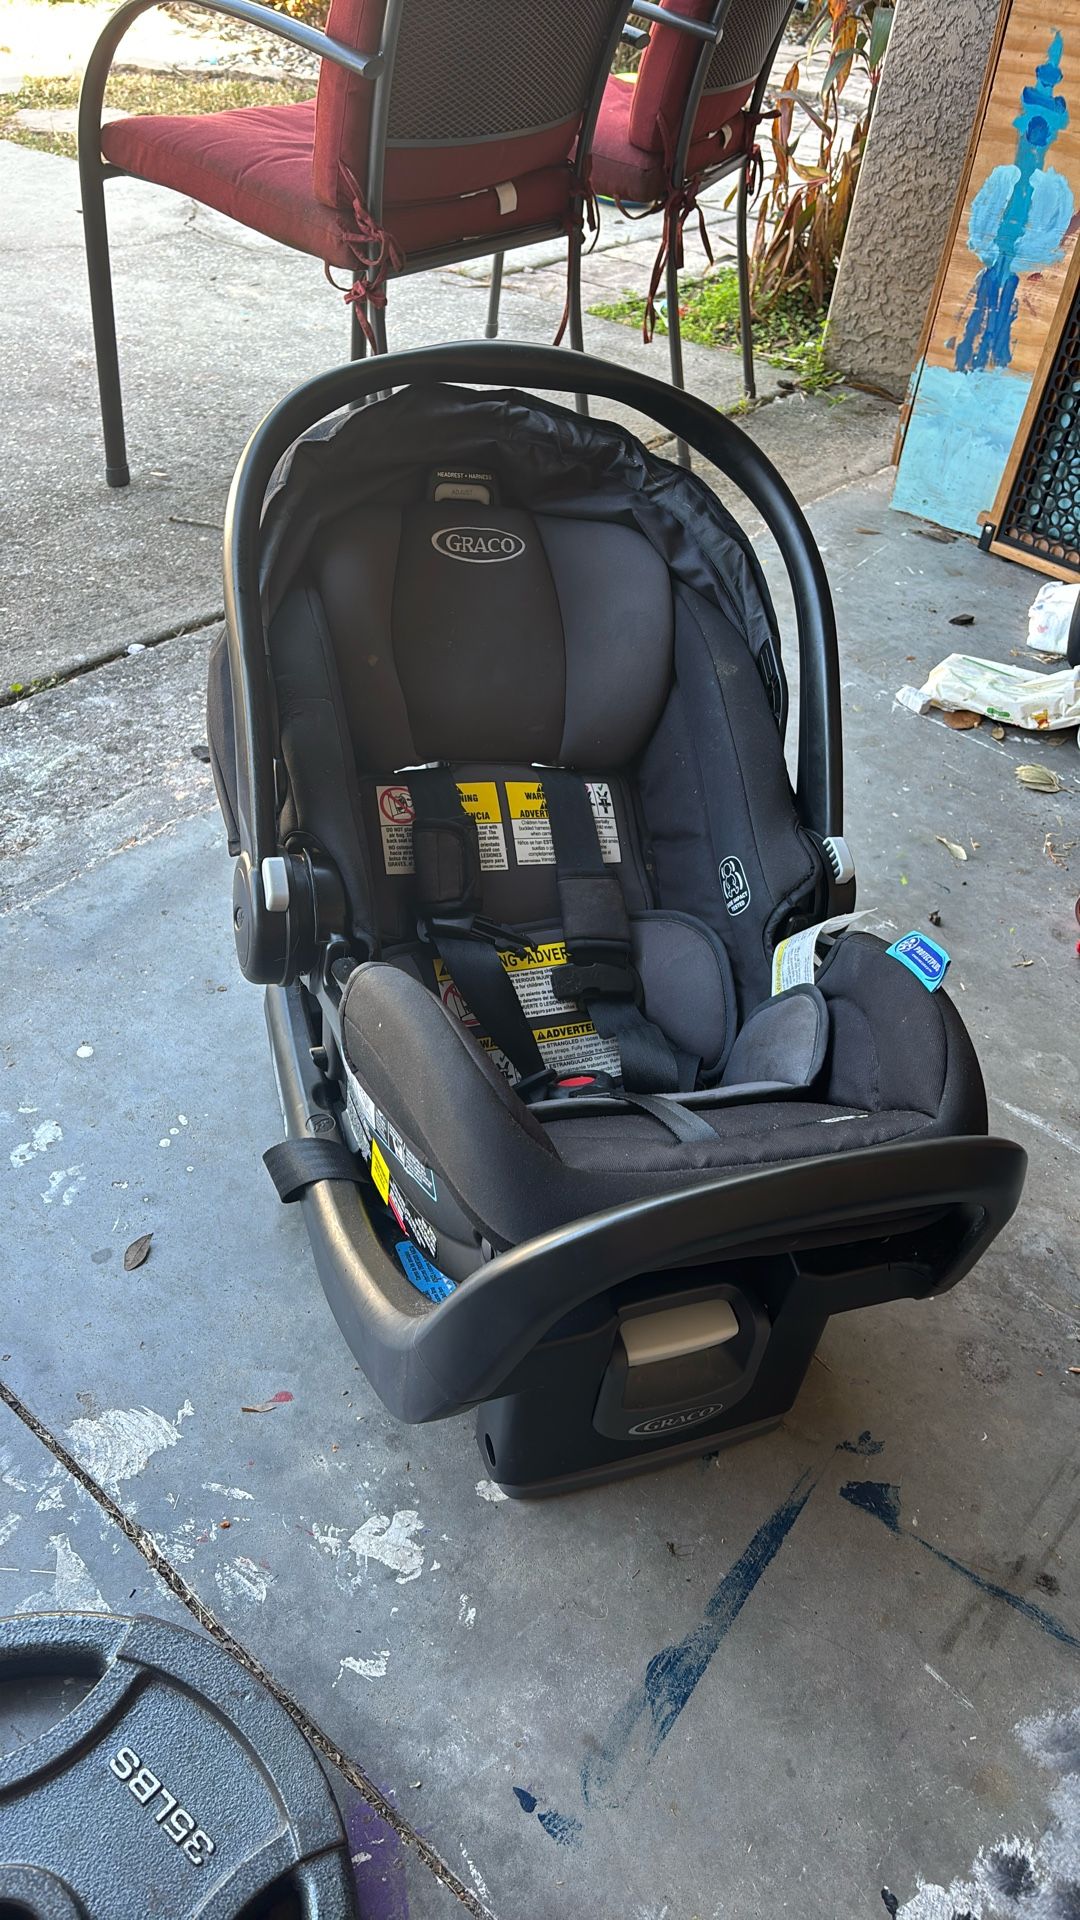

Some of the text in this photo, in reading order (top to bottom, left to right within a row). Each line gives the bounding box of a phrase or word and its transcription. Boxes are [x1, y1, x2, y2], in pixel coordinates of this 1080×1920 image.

[446, 534, 515, 553] GRACO
[913, 946, 941, 972] PROTECTPLUS
[546, 1038, 579, 1049] STRANGLED
[643, 1406, 715, 1431] GRACO
[109, 1746, 215, 1865] 35LBS
